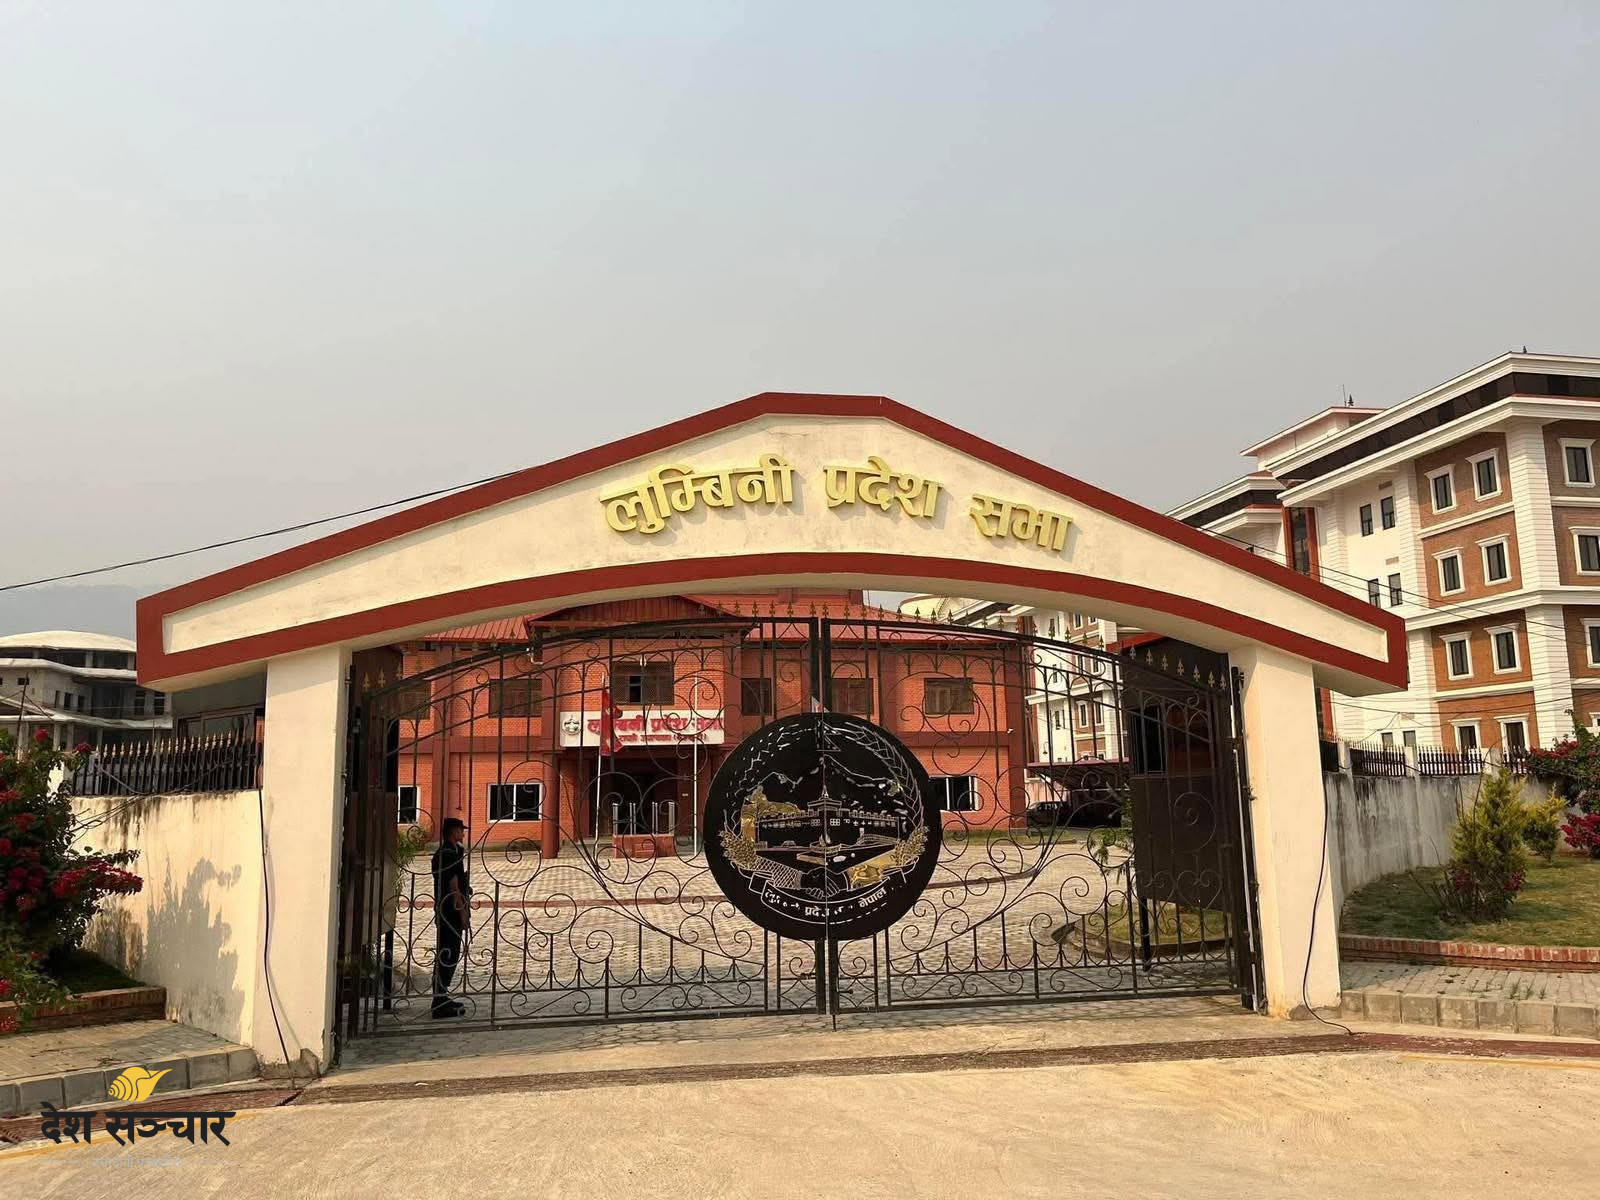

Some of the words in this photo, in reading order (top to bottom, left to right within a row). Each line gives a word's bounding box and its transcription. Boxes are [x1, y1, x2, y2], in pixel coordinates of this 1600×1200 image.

[600, 453, 795, 534] लुम्बिनी
[822, 455, 944, 518] प्रदेश
[969, 493, 1074, 552] सभा
